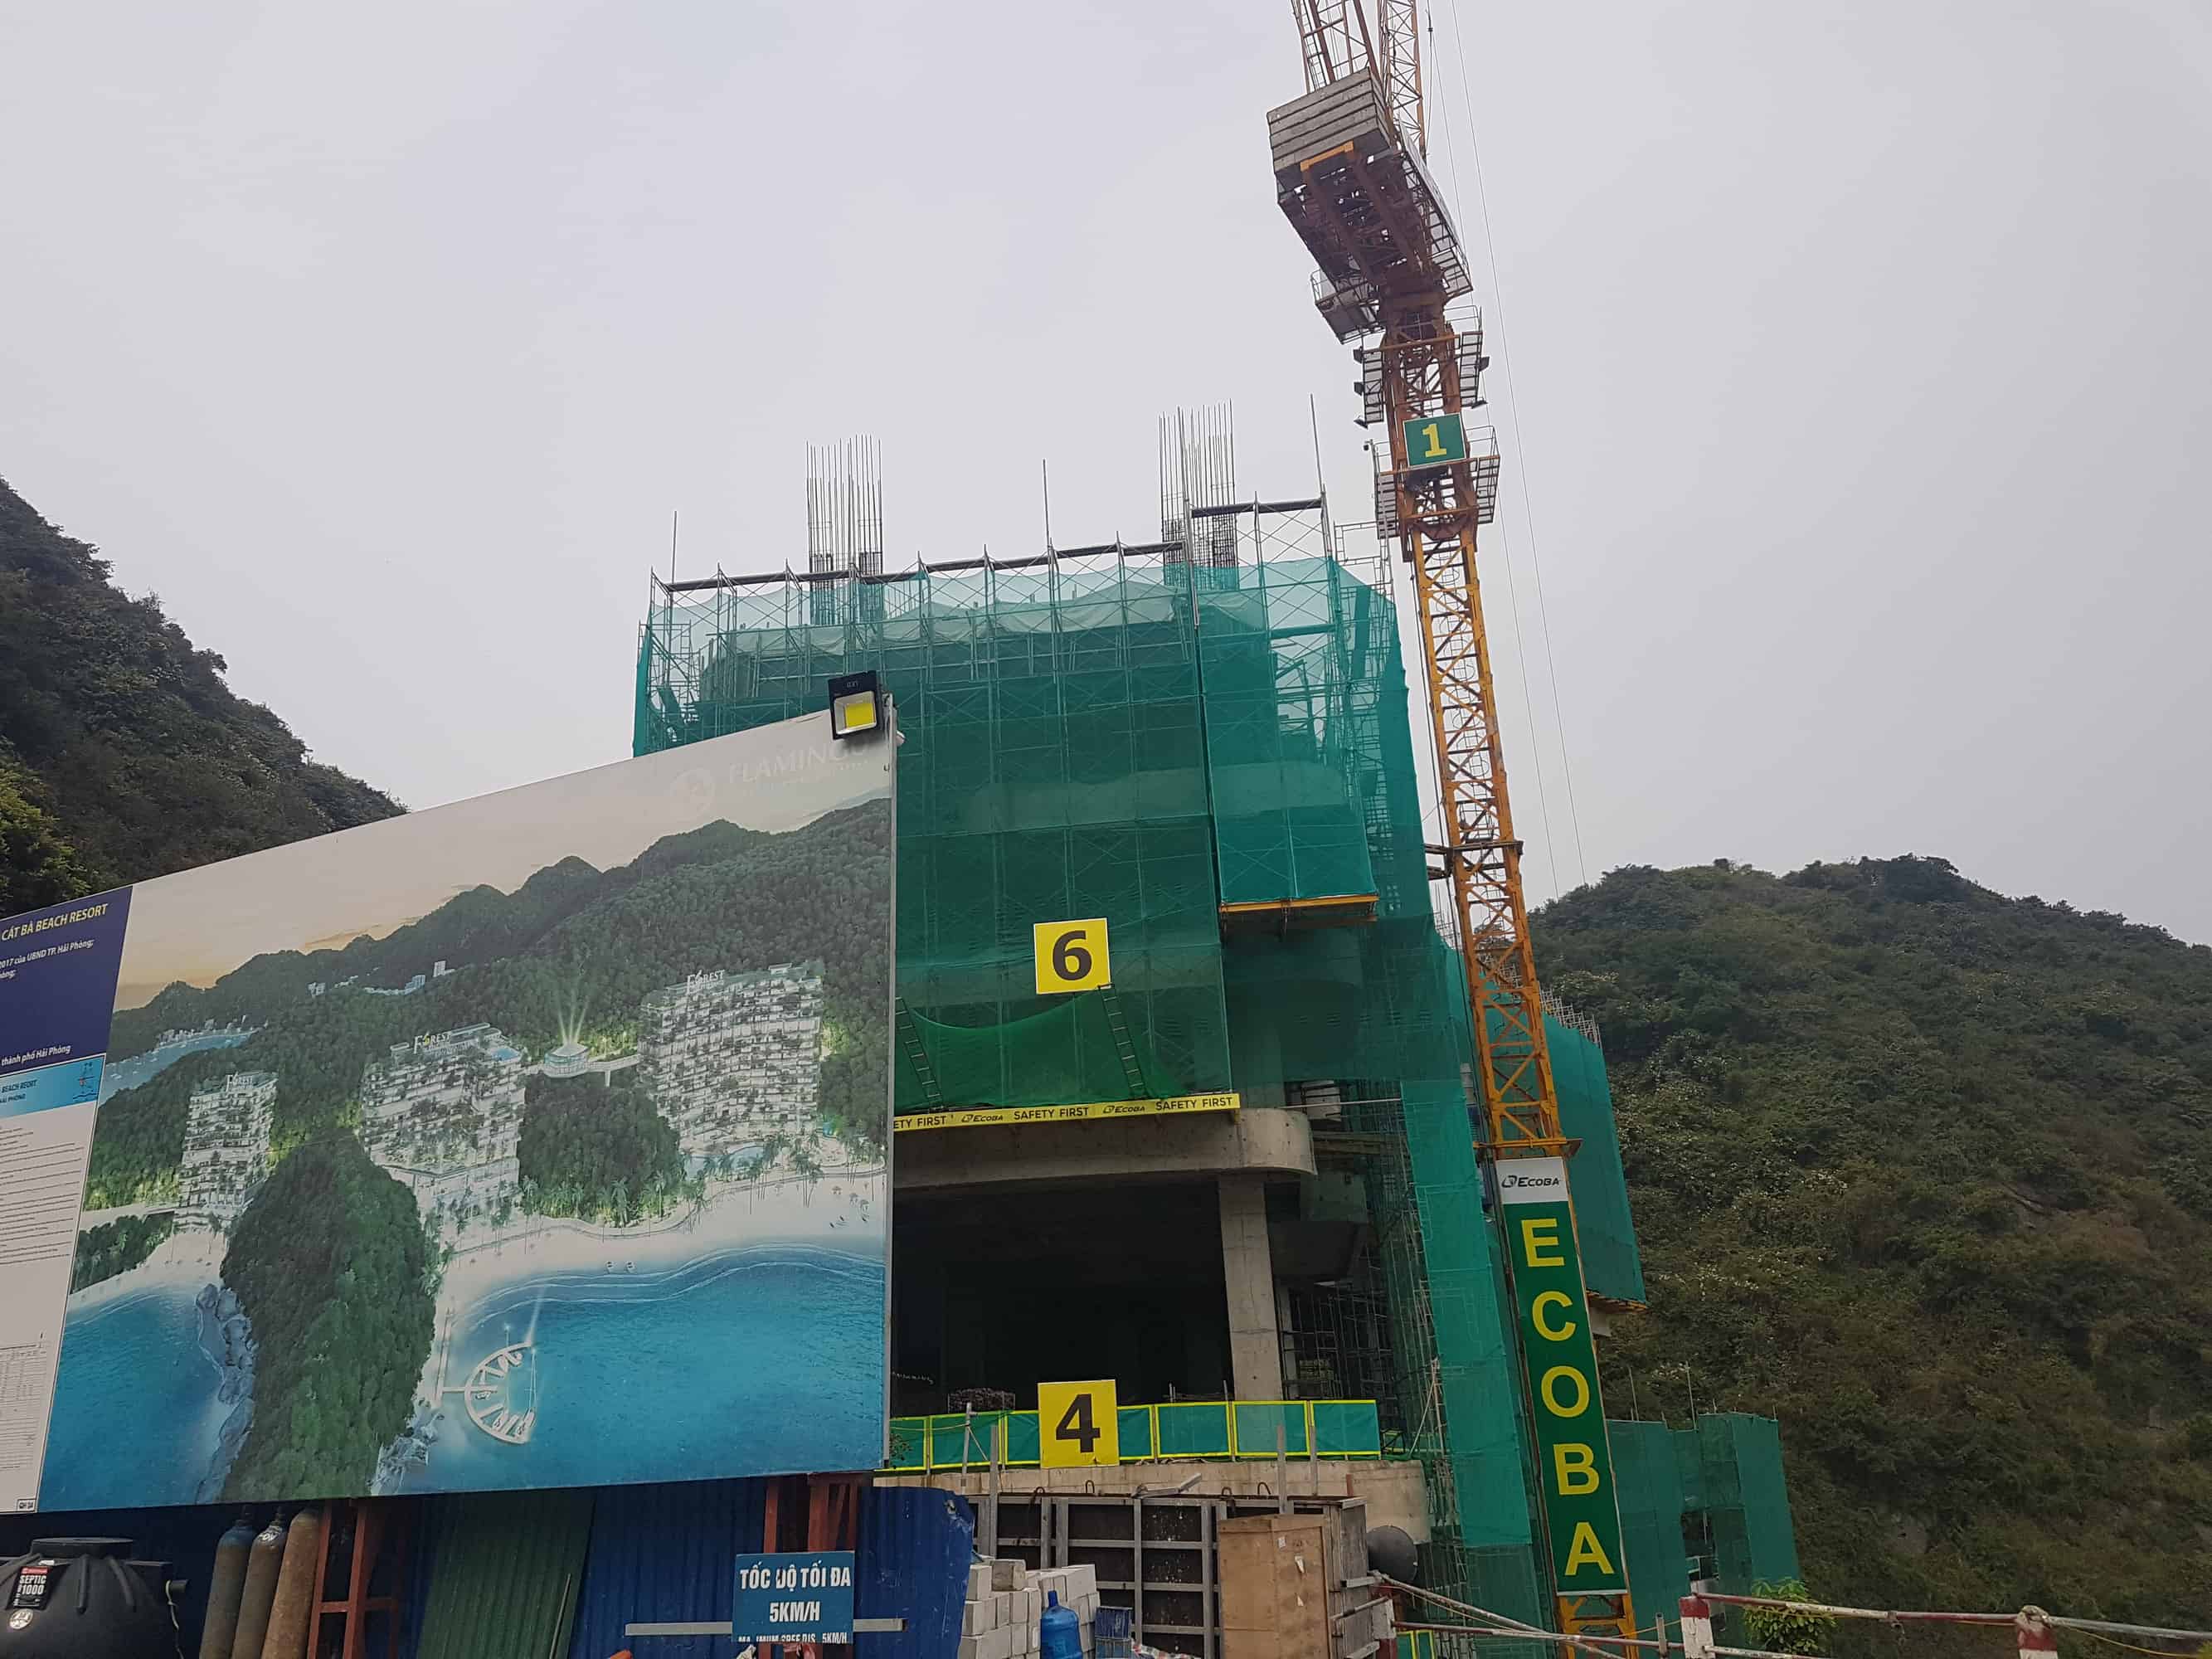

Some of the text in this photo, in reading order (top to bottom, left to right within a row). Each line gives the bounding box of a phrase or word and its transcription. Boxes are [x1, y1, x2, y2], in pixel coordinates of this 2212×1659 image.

[1422, 424, 1446, 458] 1
[729, 742, 866, 783] FLAMING
[36, 914, 68, 932] BEACH
[69, 903, 109, 922] RESORT
[1053, 930, 1092, 980] 6
[1014, 1107, 1089, 1120] SAFETY FIRST
[1155, 1097, 1233, 1111] SAFETY FIRST
[917, 1115, 946, 1126] FIRST
[1520, 1218, 1614, 1576] ECOBA
[1055, 1394, 1101, 1453] 4
[19, 1574, 47, 1584] SEPTIC
[740, 1561, 771, 1589] TỐC
[800, 1559, 826, 1588] TỐI
[830, 1567, 851, 1587] ĐA
[22, 1584, 45, 1595] 1000
[770, 1601, 821, 1623] 5KM/H
